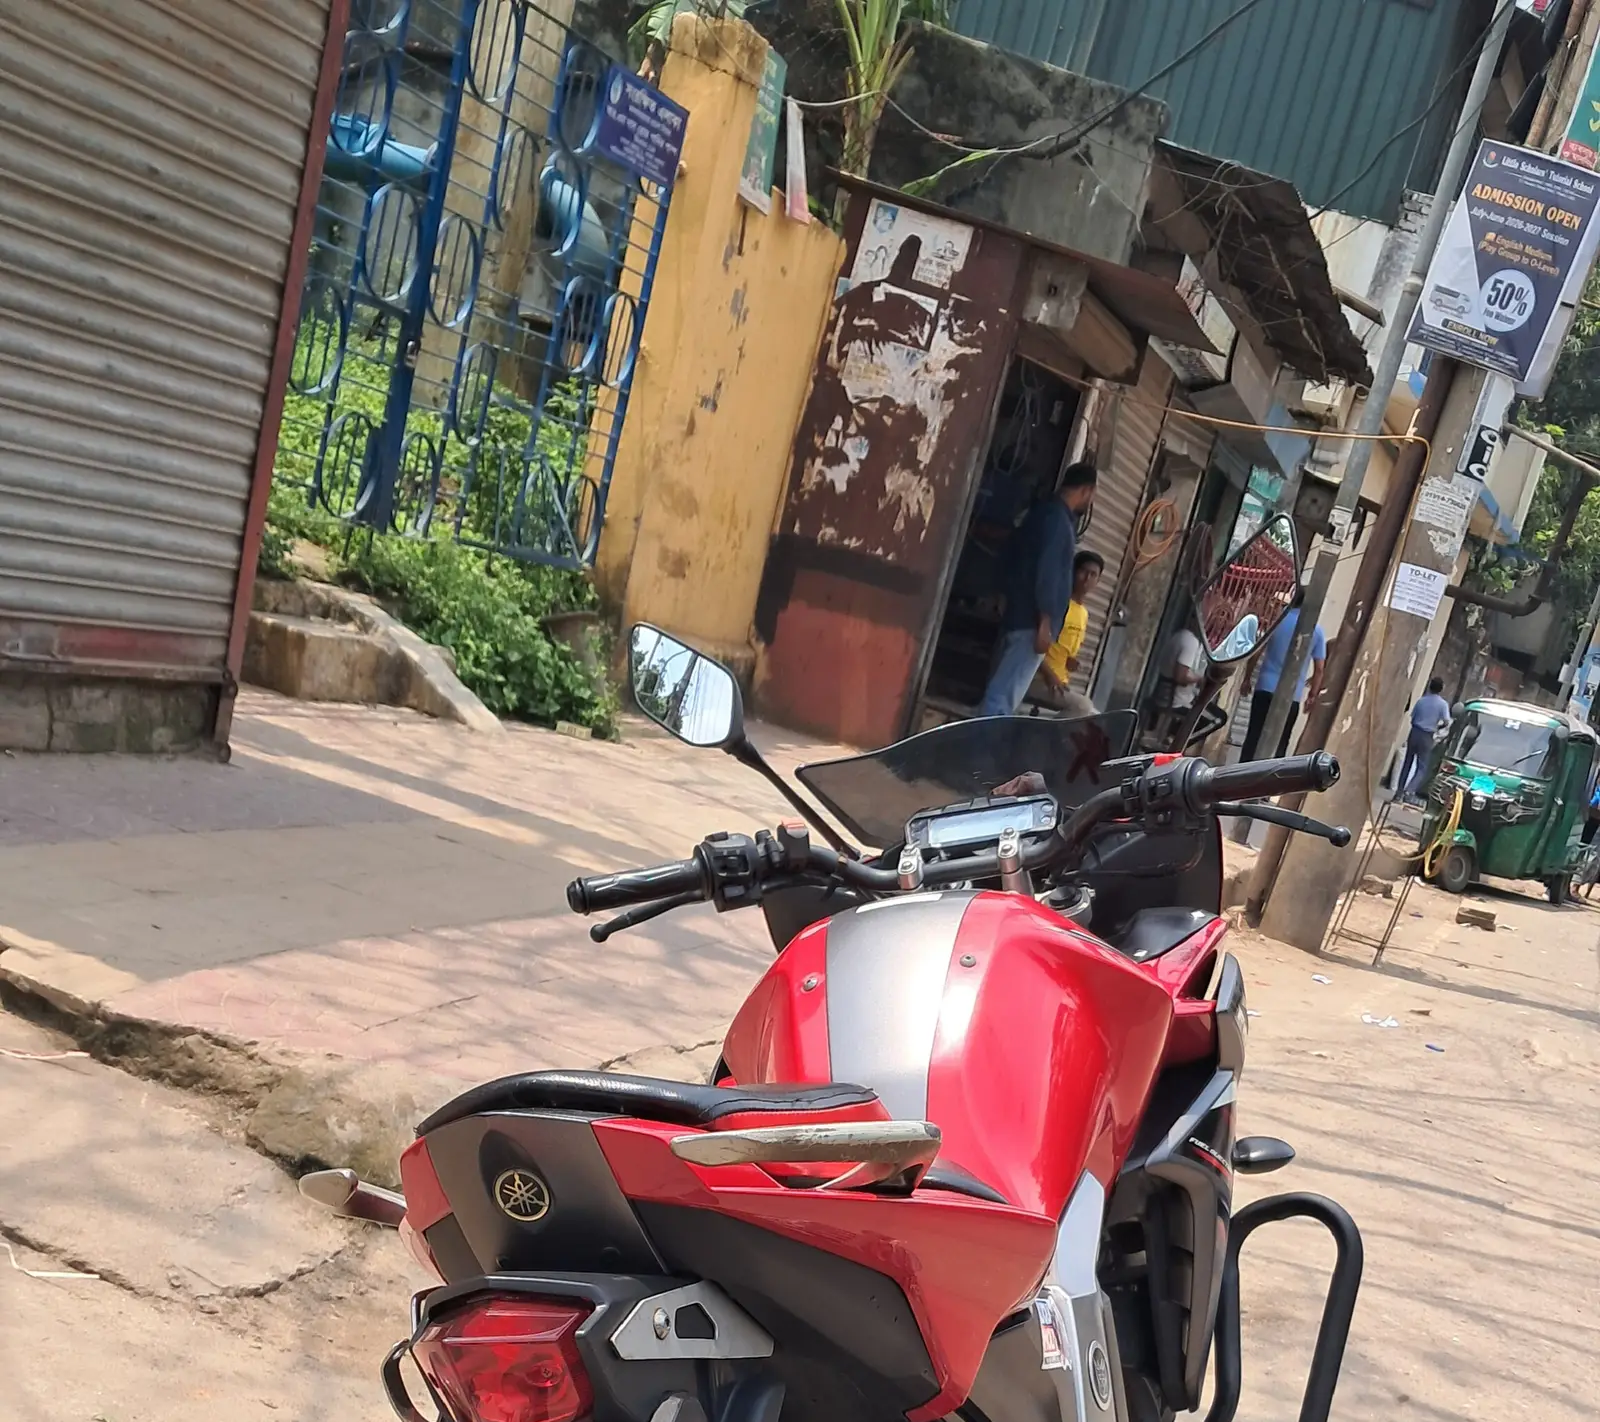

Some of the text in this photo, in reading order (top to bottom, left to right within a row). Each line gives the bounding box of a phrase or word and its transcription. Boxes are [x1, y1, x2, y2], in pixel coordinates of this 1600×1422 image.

[1502, 155, 1520, 170] Little
[1547, 165, 1572, 187] Tutorial
[1571, 173, 1594, 194] School
[1471, 183, 1545, 217] ADMISSION
[1546, 205, 1582, 230] OPEN
[1541, 228, 1570, 246] Session
[1486, 277, 1531, 317] 50%
[1408, 567, 1438, 582] TO-LET
